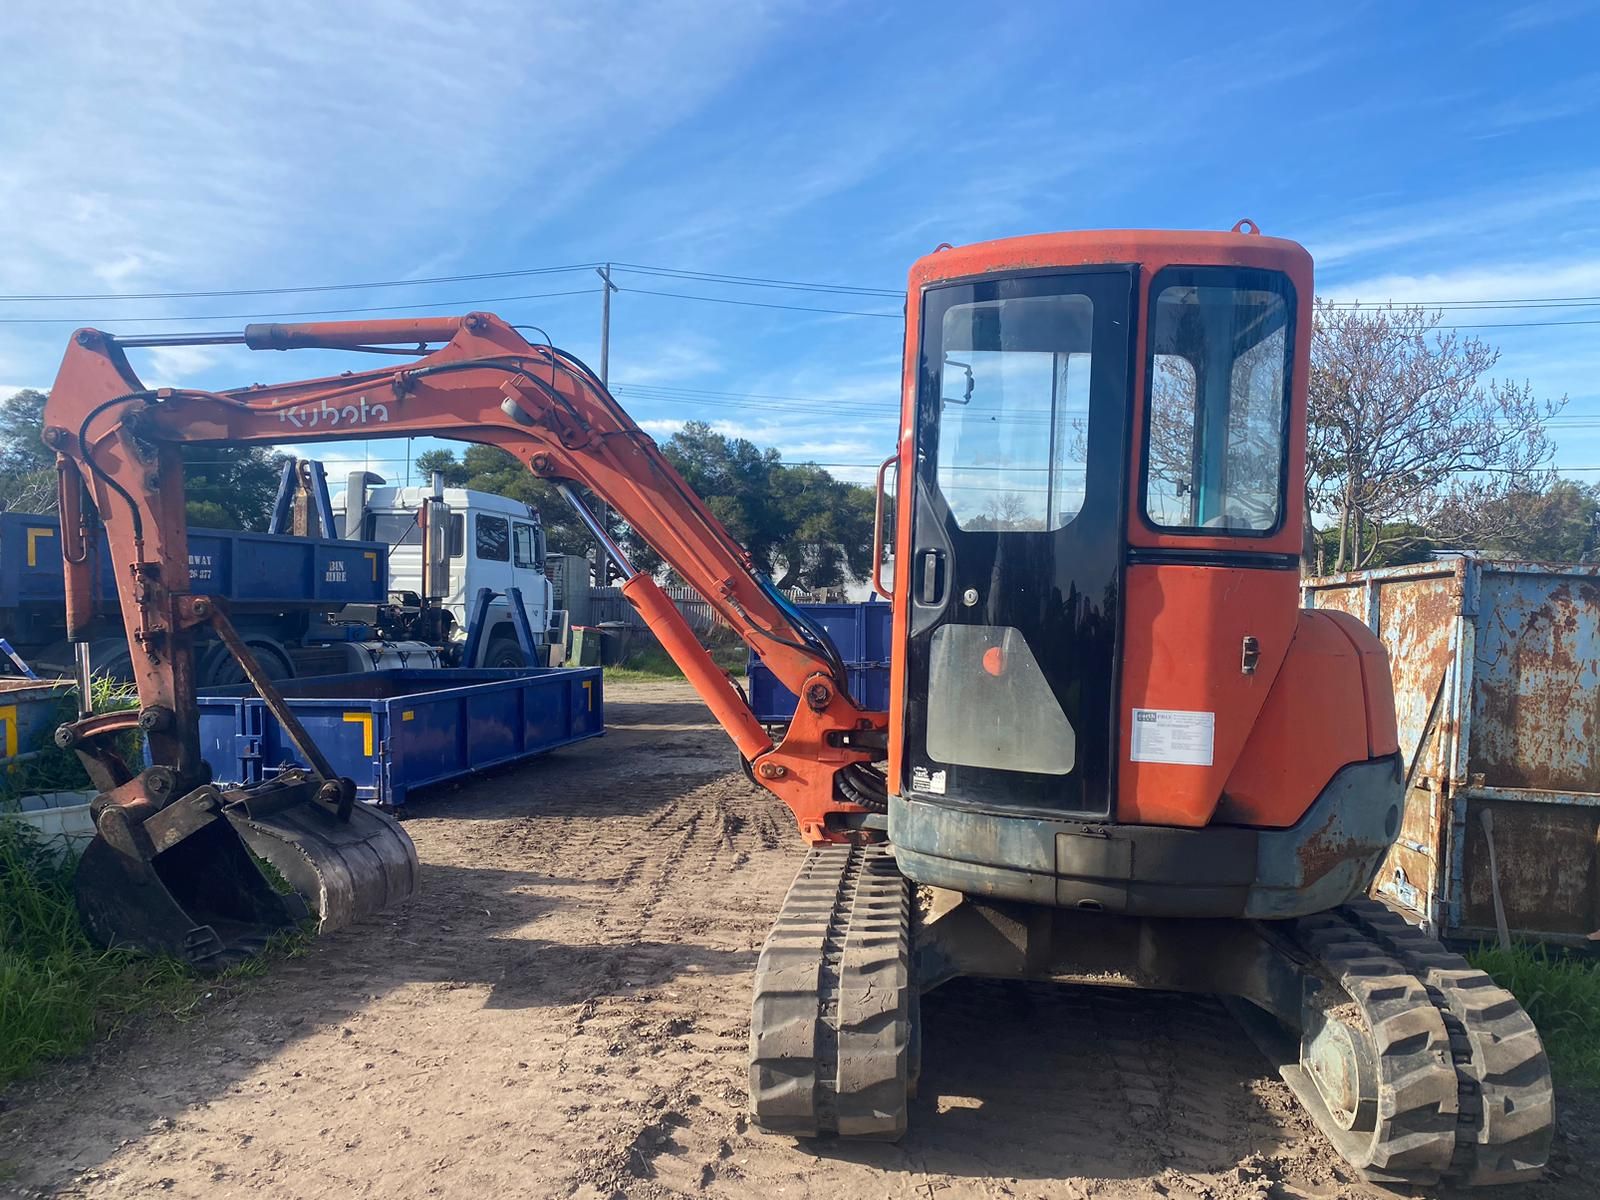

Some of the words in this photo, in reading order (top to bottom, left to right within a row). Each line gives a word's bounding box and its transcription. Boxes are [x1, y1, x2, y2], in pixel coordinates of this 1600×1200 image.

[279, 397, 389, 428] Kubota
[329, 560, 345, 571] BIN
[325, 571, 347, 582] HIRE
